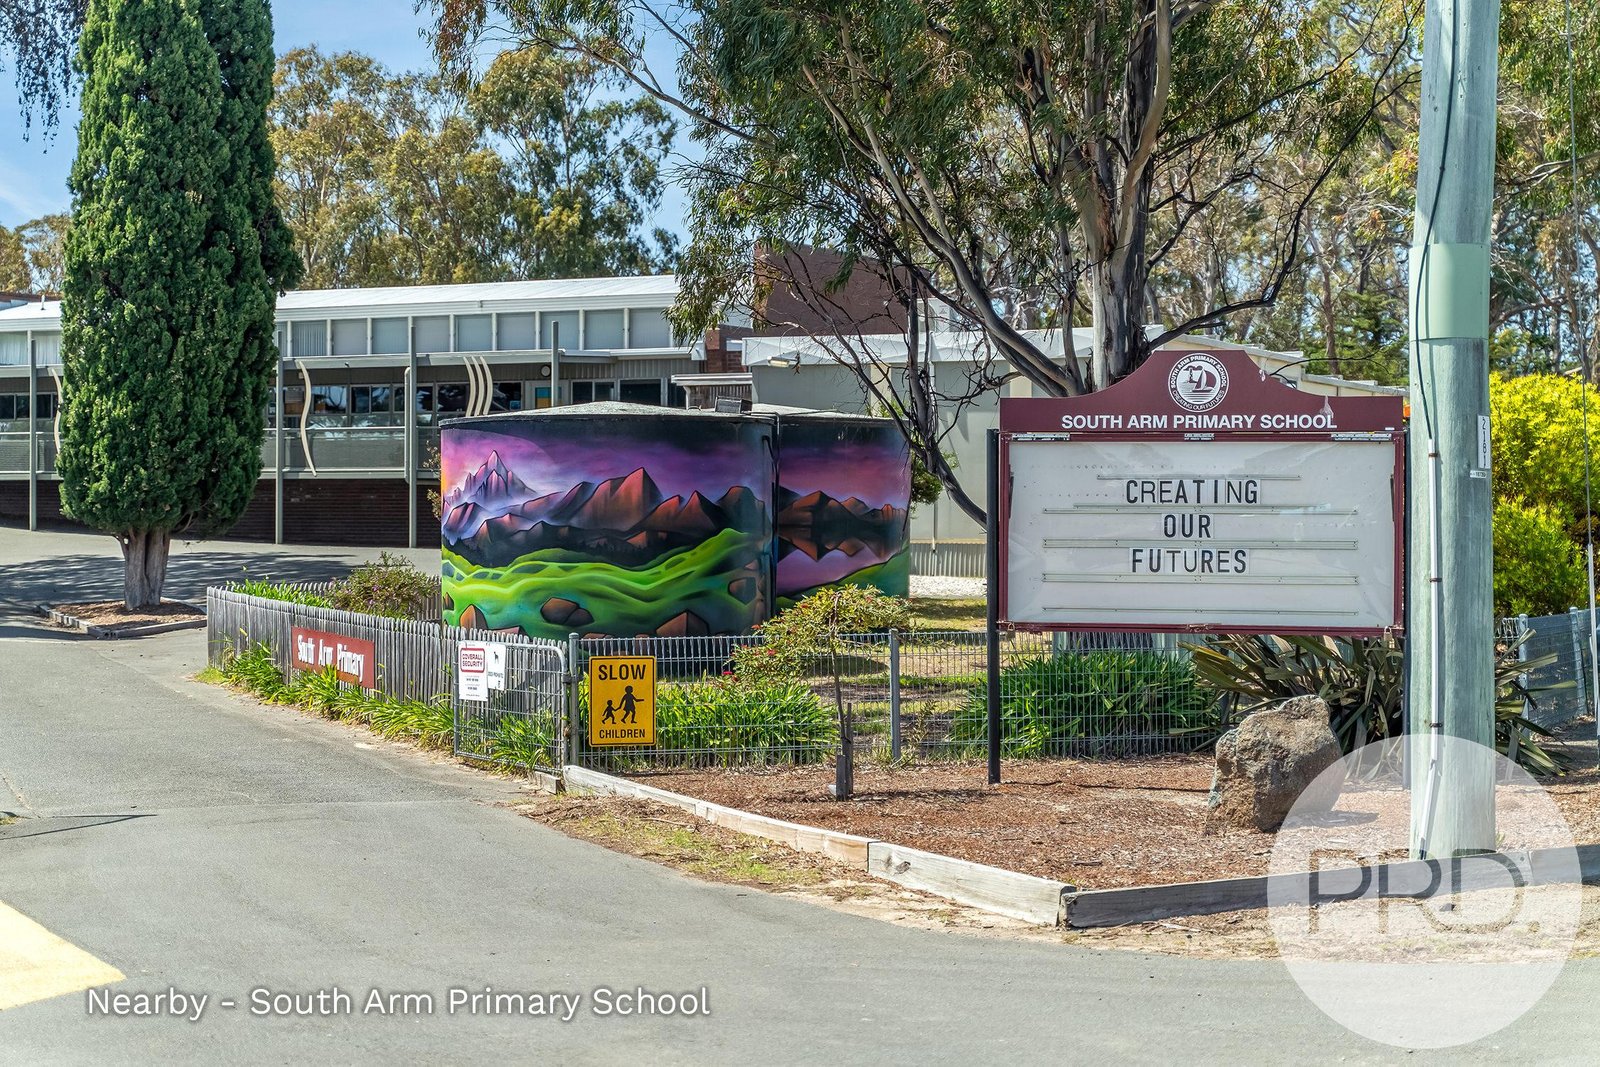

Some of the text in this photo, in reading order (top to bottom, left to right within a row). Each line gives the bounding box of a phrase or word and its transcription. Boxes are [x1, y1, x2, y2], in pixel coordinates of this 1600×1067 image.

[1170, 355, 1227, 388] SOUTH ARM PRIMARY SCHOOL
[1061, 414, 1337, 429] SOUTH ARM PRIMARY SCHOOL
[1126, 480, 1258, 504] CREATING
[1164, 514, 1211, 538] OUR
[1132, 549, 1247, 574] FUTURES
[598, 664, 647, 680] SLOW
[599, 728, 646, 739] CHILDREN
